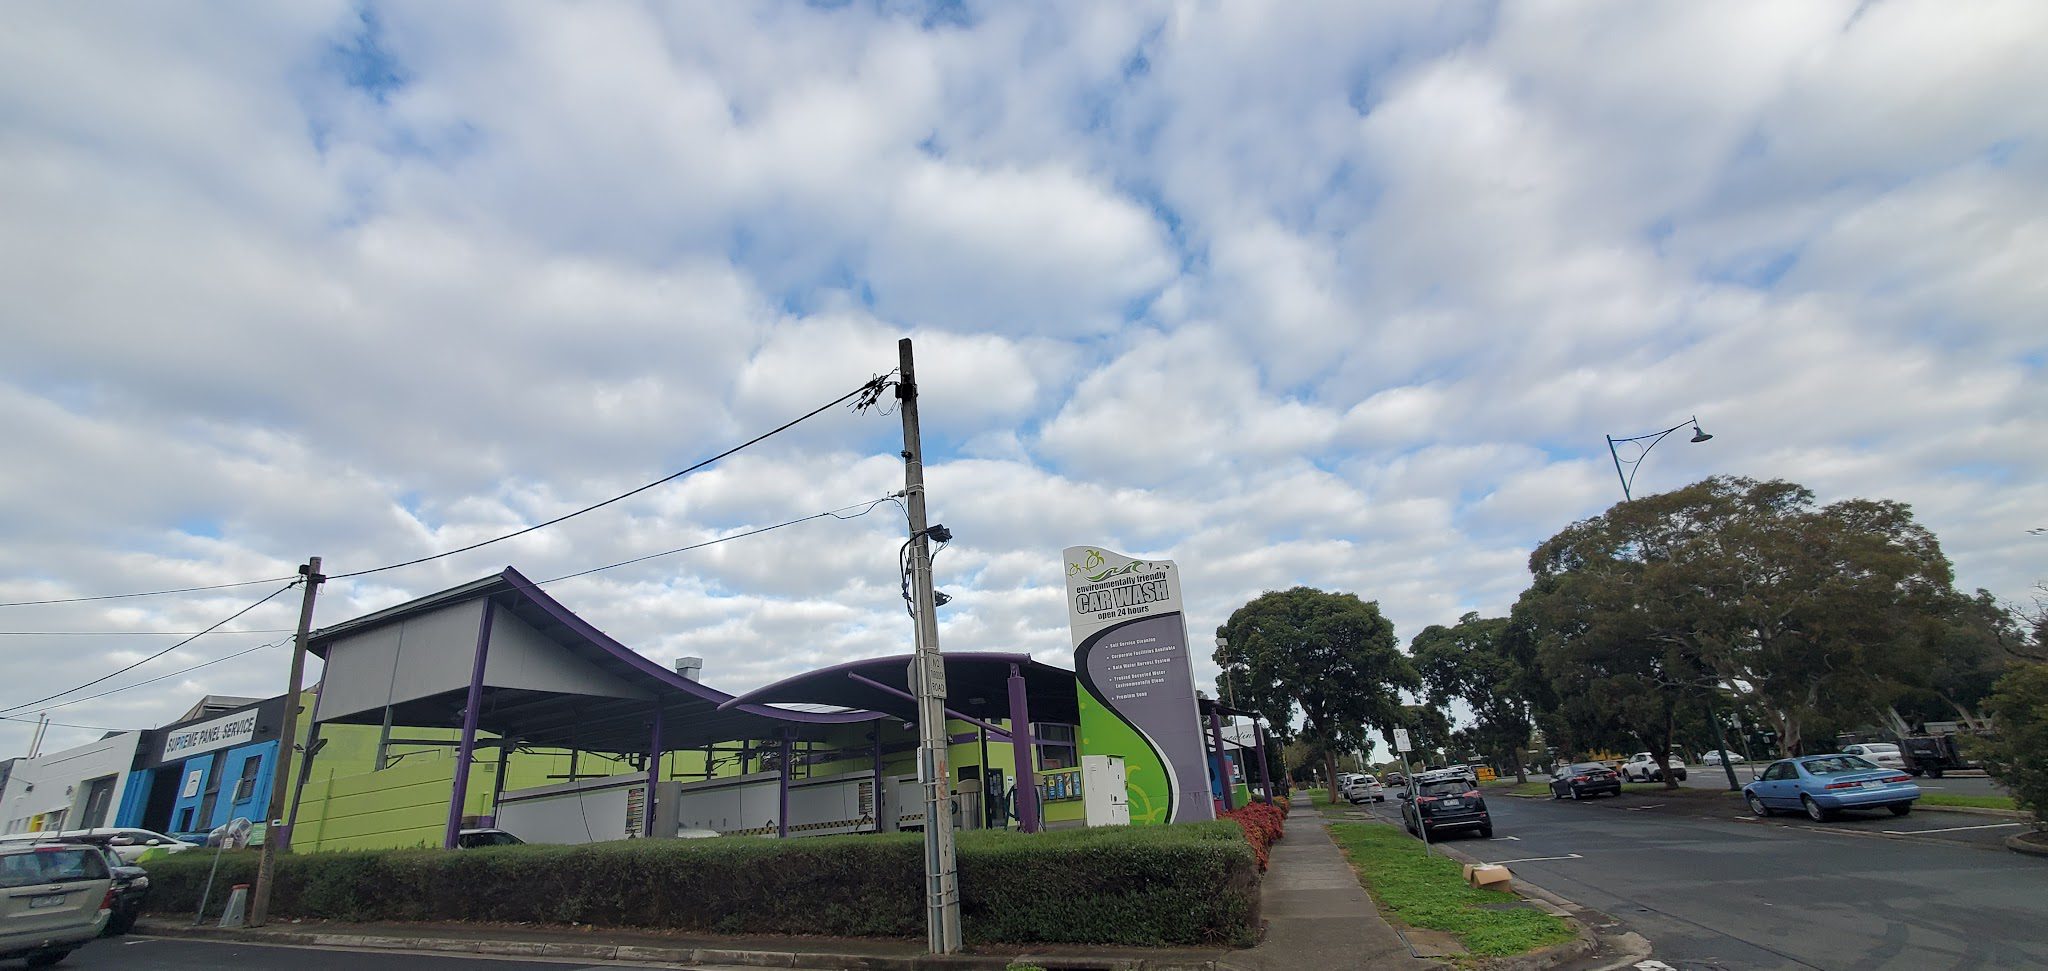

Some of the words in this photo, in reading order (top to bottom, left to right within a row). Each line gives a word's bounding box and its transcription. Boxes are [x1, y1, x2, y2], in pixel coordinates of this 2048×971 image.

[1076, 576, 1136, 593] environmentally
[1136, 571, 1166, 583] friendly
[1076, 590, 1112, 614] CAR
[1113, 580, 1169, 607] WASH
[1097, 610, 1116, 620] open
[1117, 607, 1126, 617] 24
[1127, 605, 1149, 615] hours
[932, 682, 944, 693] ROAD
[166, 731, 199, 753] SUPREME
[198, 726, 221, 745] PANEL
[222, 717, 255, 739] SERVICE
